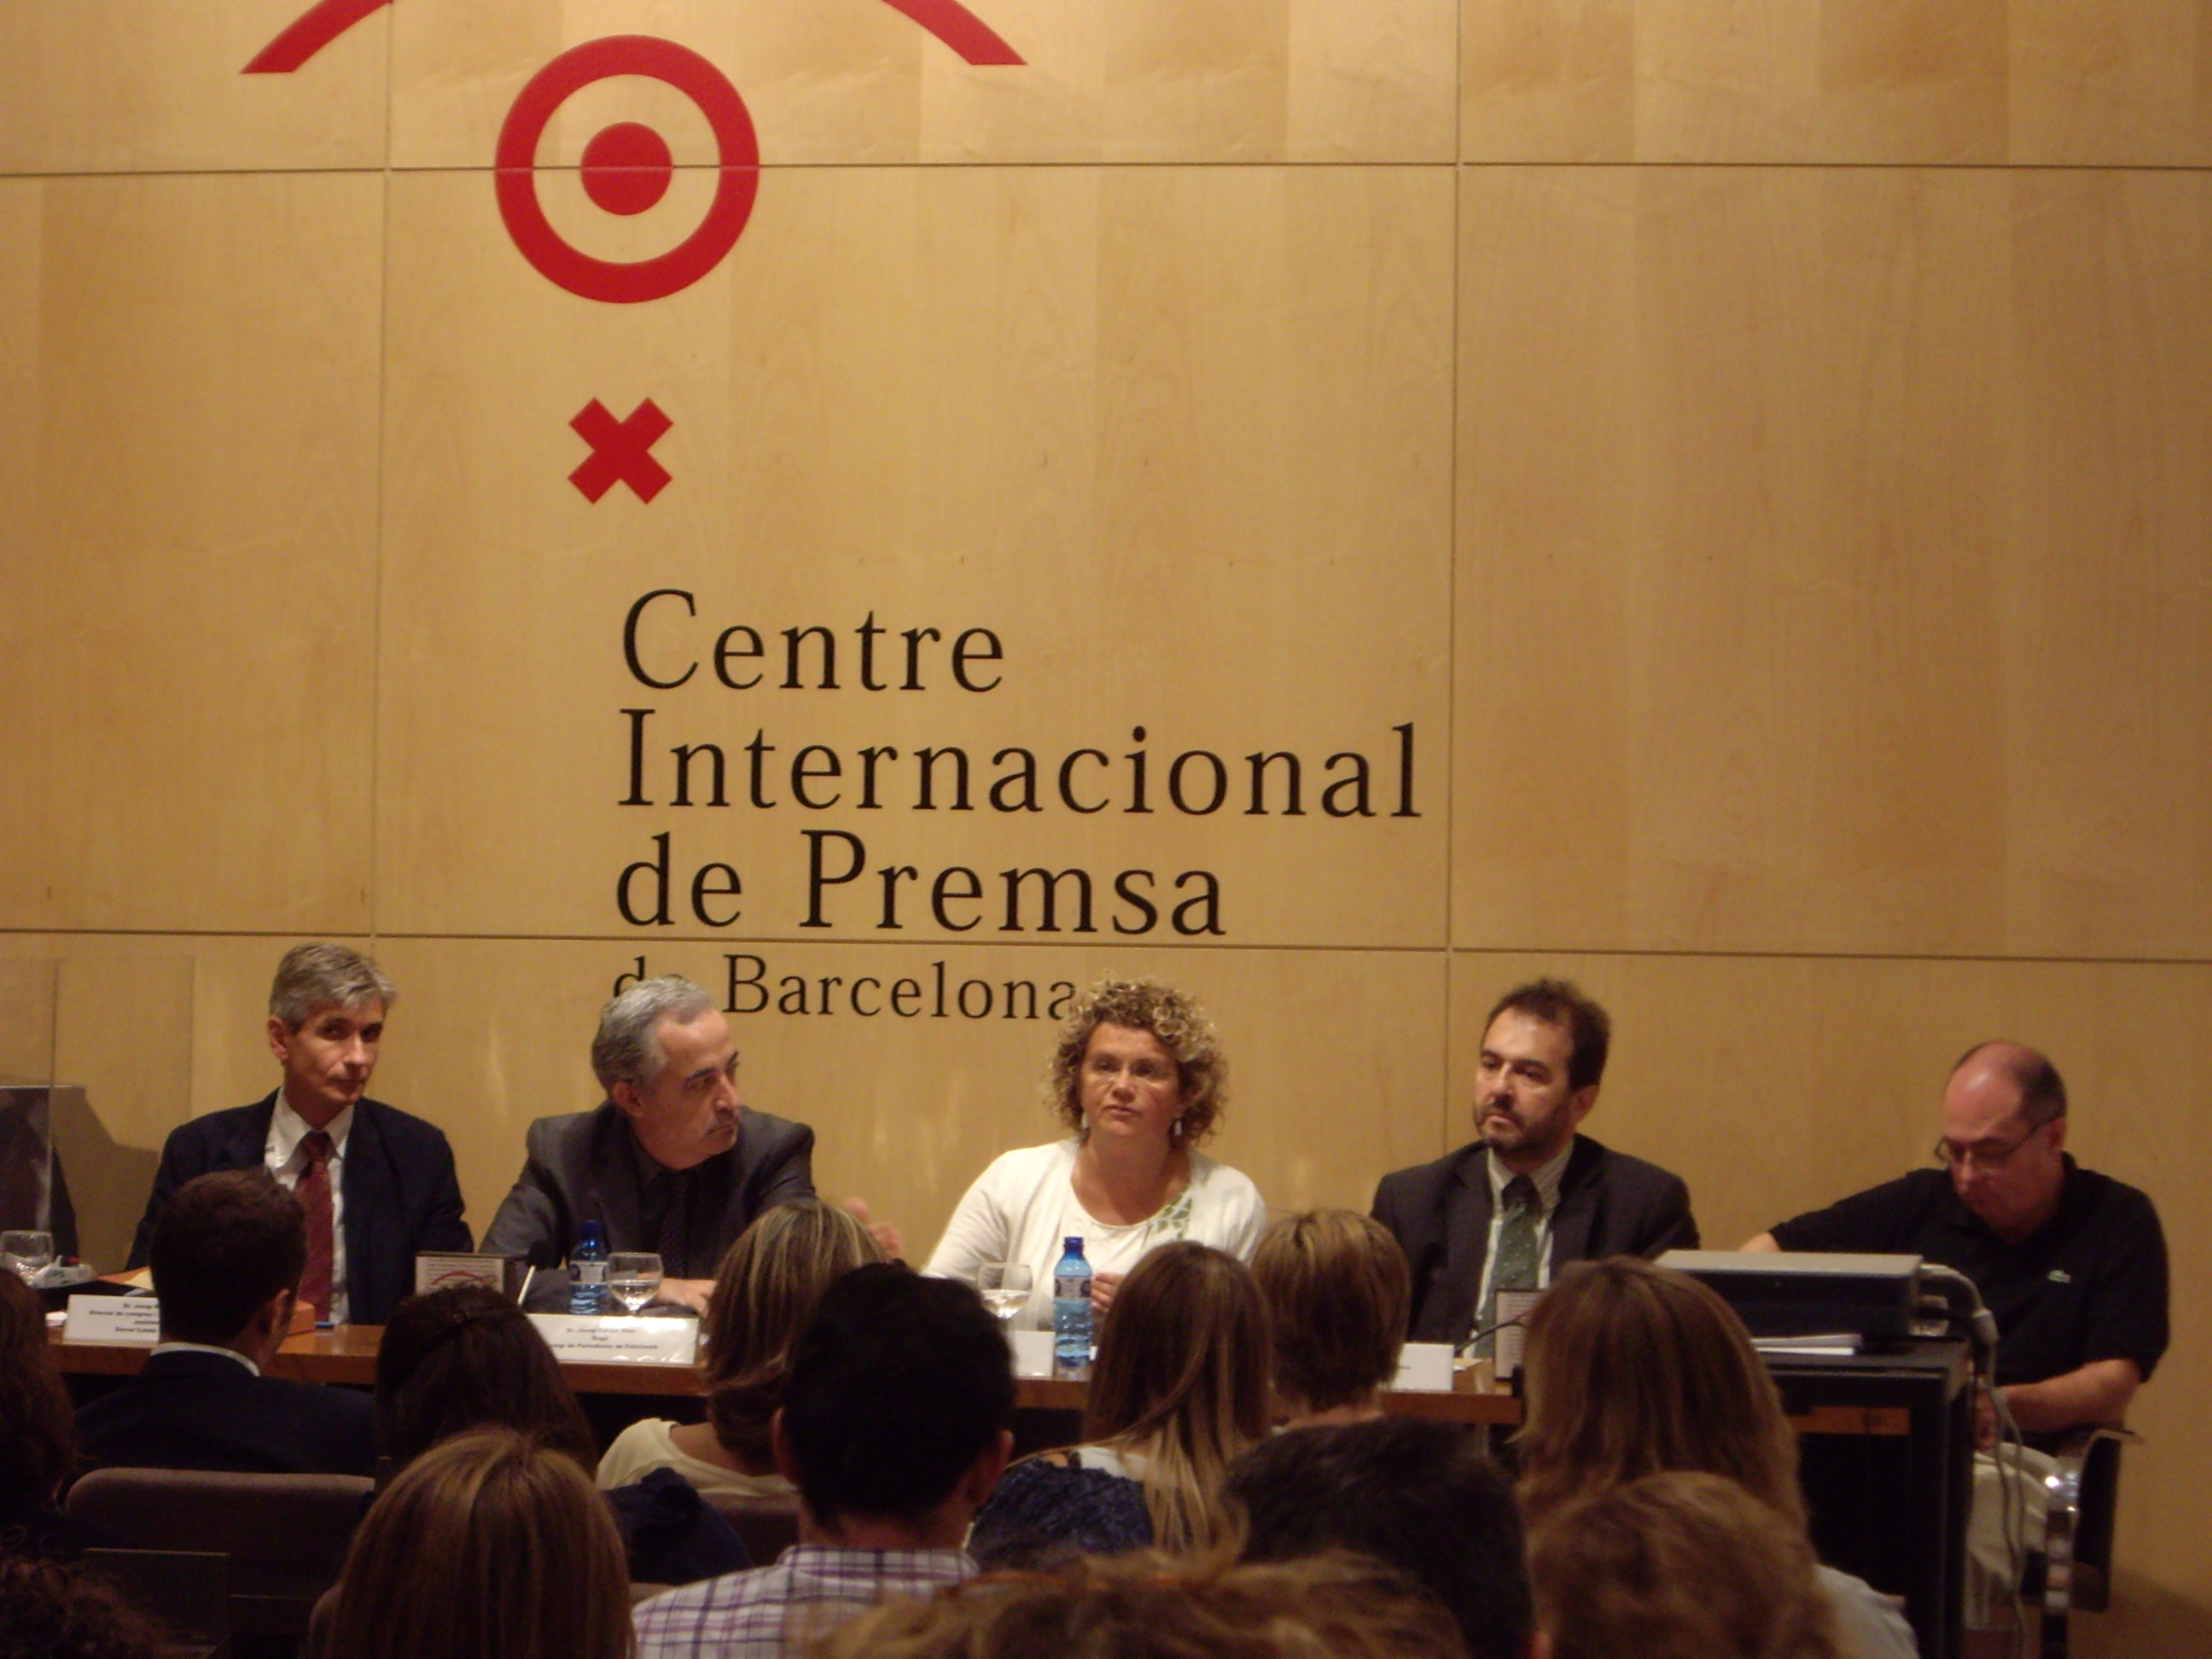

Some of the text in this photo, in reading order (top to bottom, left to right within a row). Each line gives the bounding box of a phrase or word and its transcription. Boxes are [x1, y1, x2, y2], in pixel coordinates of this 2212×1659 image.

[623, 588, 1004, 693] Centre
[618, 707, 1422, 818] Internacional
[615, 829, 1226, 937] de Premsa
[722, 953, 1076, 1021] Barcelona
